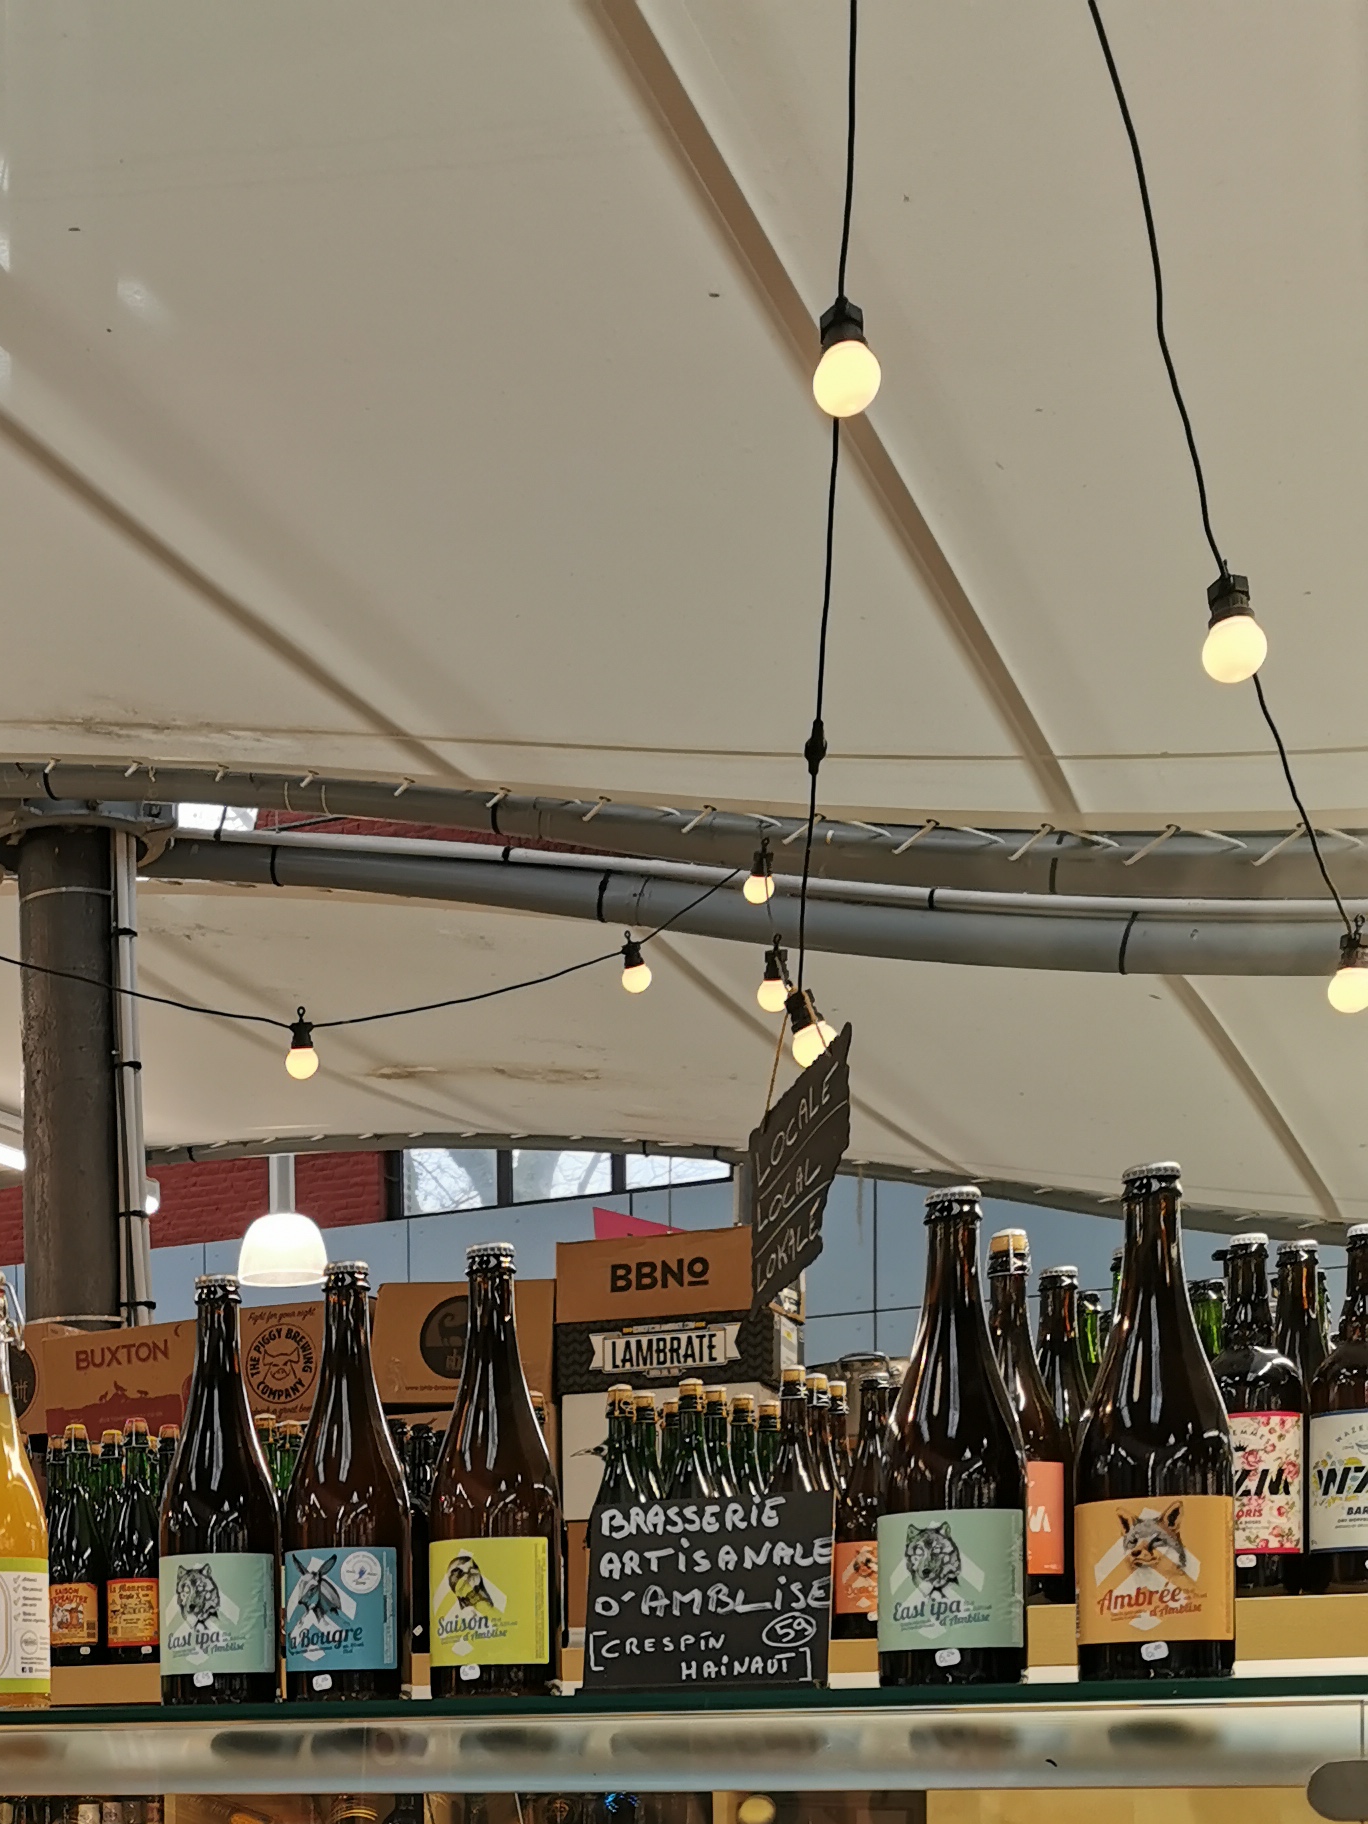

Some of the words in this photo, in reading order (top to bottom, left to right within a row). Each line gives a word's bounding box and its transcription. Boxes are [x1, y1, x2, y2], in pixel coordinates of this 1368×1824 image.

[756, 1158, 822, 1233] LOCAL
[253, 1327, 283, 1355] PIGGY
[285, 1327, 314, 1374] BREWING
[611, 1333, 718, 1369] LAMBRATE
[75, 1338, 170, 1372] BUXTON
[250, 1356, 260, 1378] THE
[256, 1378, 305, 1400] COMPANY
[1232, 1429, 1271, 1445] EMMES
[1335, 1424, 1368, 1443] WAZE
[600, 1494, 787, 1540] BRASSERIE
[1236, 1508, 1263, 1520] ORIS
[1346, 1506, 1368, 1516] BAR
[599, 1536, 834, 1580] ARTISANALE
[1097, 1581, 1182, 1616] Ambrée
[893, 1600, 925, 1622] East
[930, 1599, 962, 1623] ipa
[437, 1613, 490, 1637] Saison
[299, 1626, 364, 1650] Bougre
